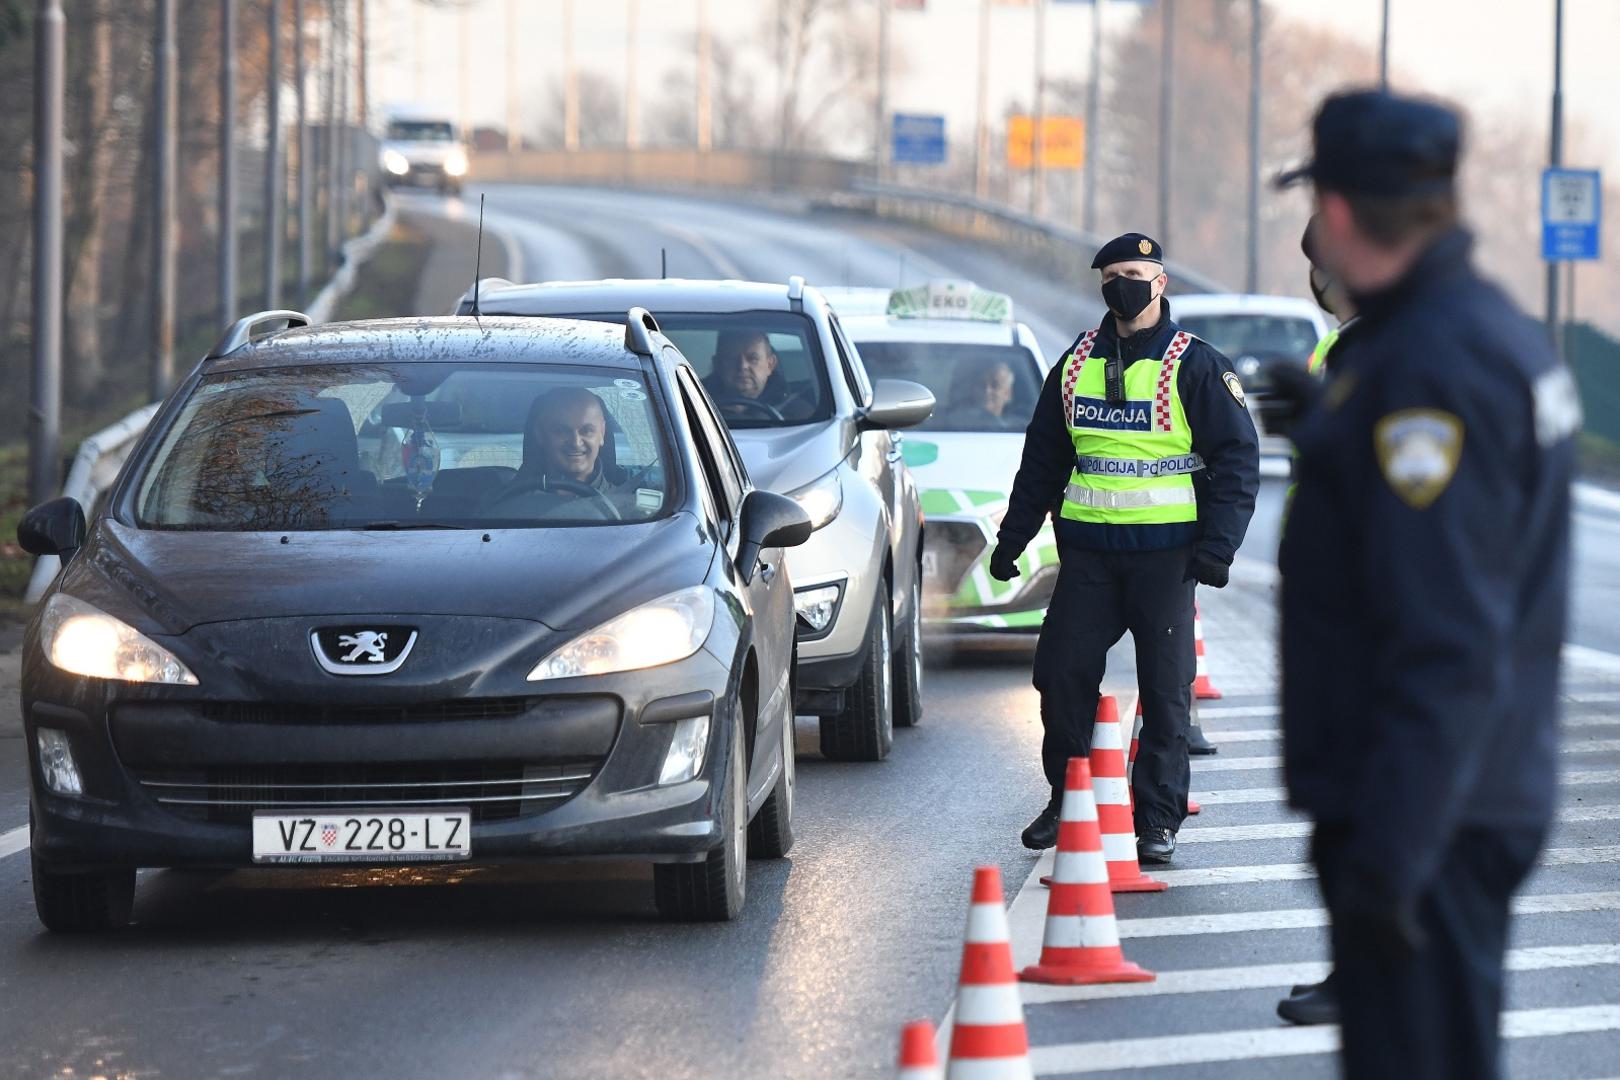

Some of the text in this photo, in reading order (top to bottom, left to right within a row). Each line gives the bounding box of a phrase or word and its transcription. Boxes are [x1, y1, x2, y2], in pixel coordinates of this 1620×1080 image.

[932, 295, 968, 309] EKO
[1075, 404, 1147, 424] POLICIJA
[1087, 459, 1136, 474] POLICIJA
[345, 818, 462, 850] 228-LZ
